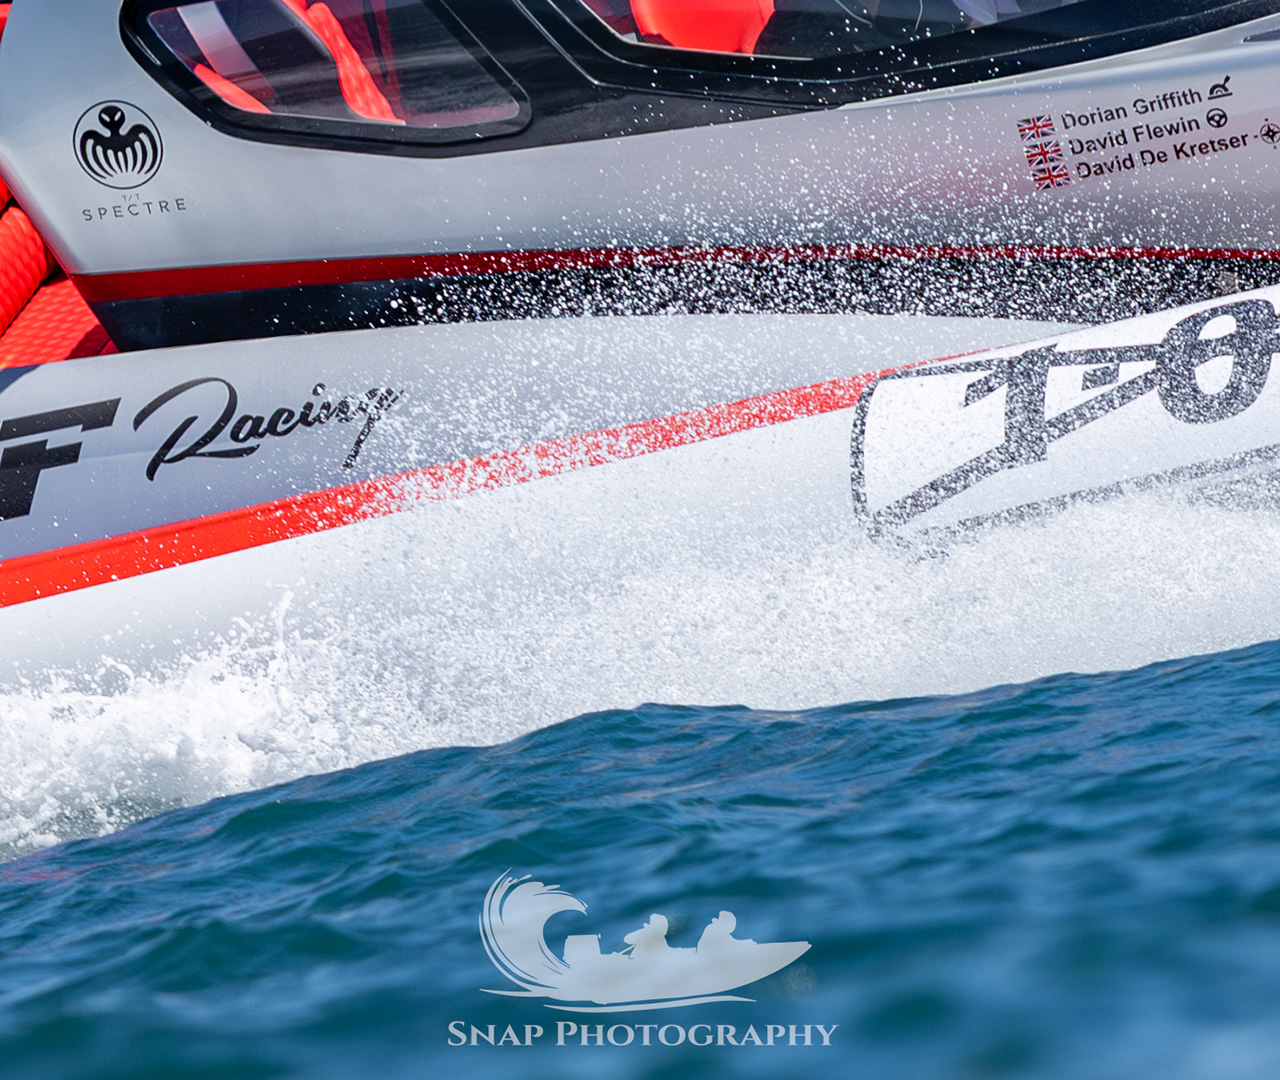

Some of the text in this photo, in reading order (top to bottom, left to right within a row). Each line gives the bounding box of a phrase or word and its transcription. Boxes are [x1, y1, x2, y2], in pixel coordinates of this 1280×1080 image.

[1061, 88, 1202, 130] Dorian Griffith
[1069, 117, 1200, 155] David Flewin
[1076, 133, 1249, 179] David De Kretser
[82, 198, 187, 221] SPECTRE
[133, 377, 405, 482] Racing
